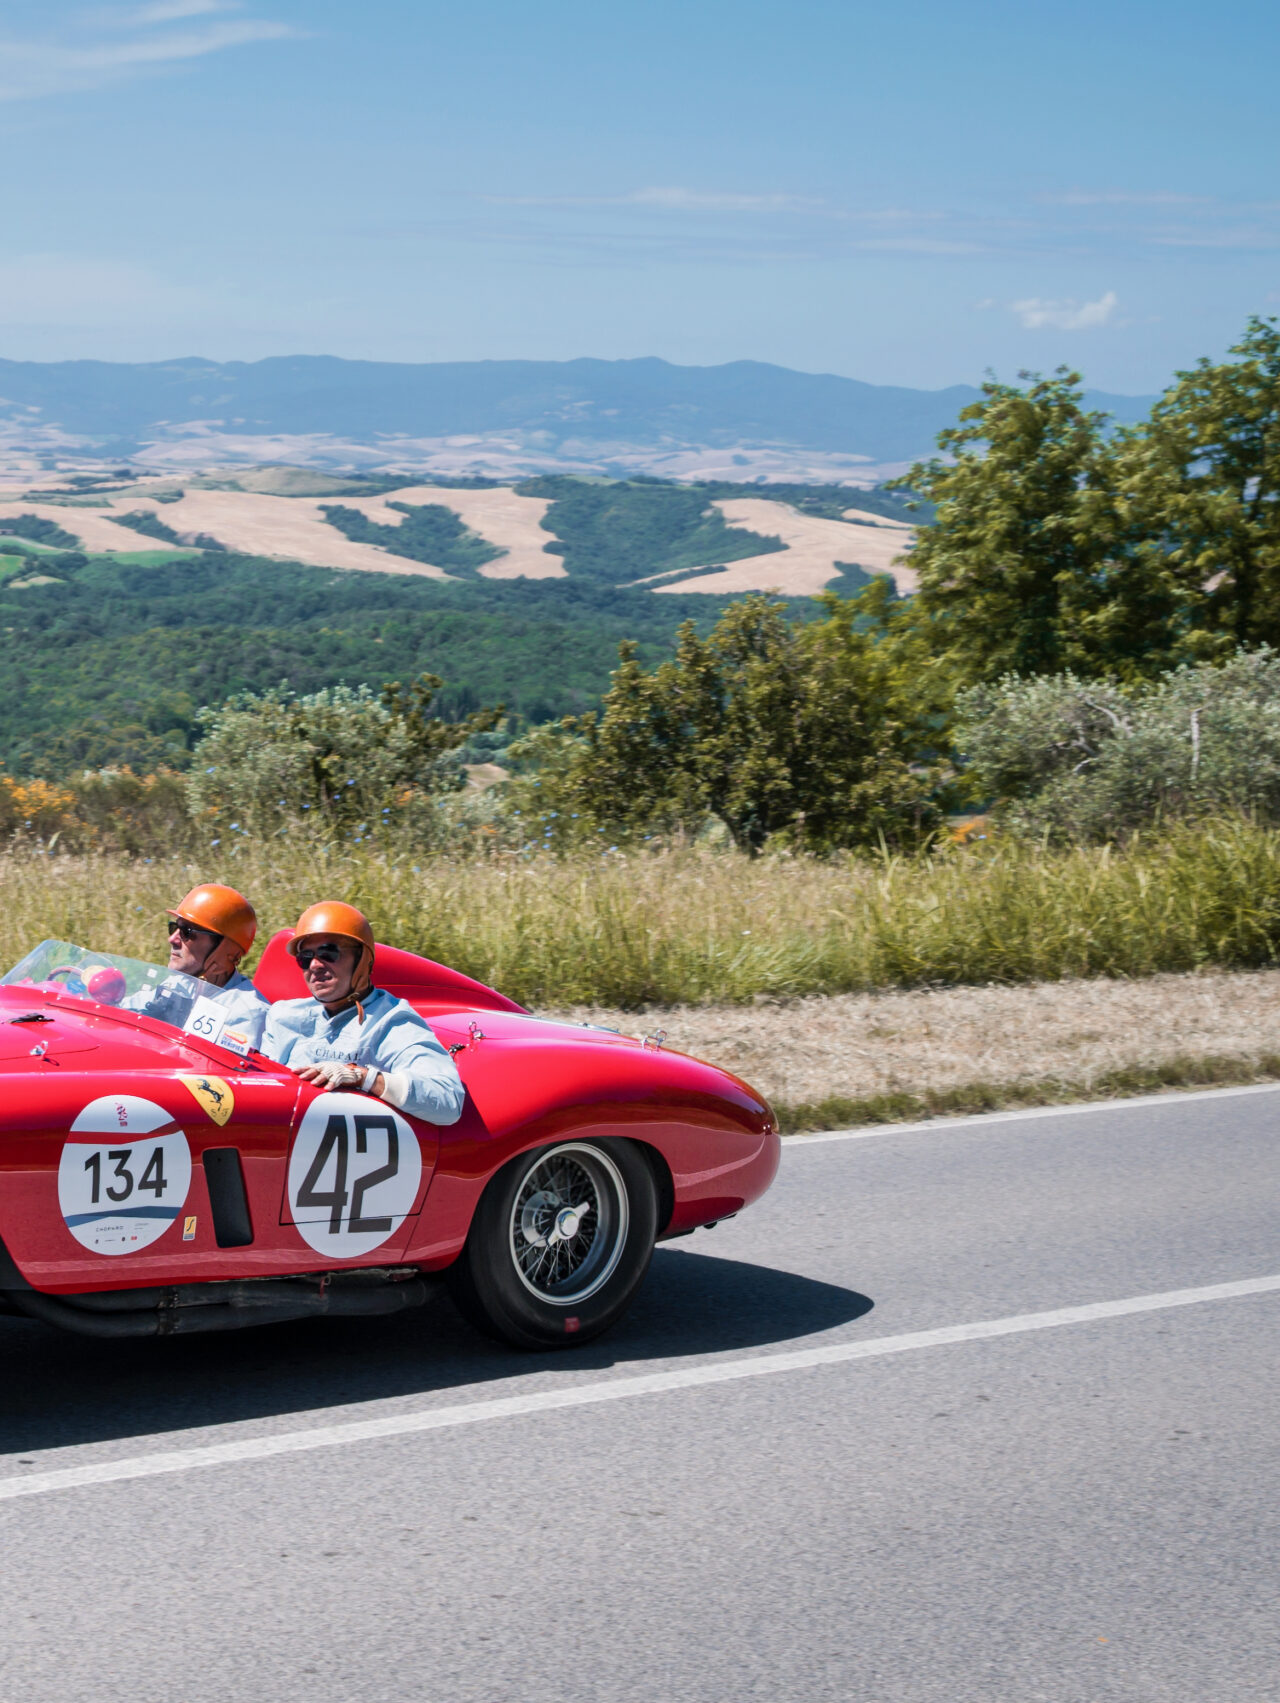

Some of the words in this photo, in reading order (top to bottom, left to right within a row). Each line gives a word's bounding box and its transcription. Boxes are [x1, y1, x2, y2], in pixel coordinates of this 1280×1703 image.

[193, 1015, 216, 1035] 65
[84, 1146, 168, 1204] 134
[295, 1114, 400, 1235] 42
